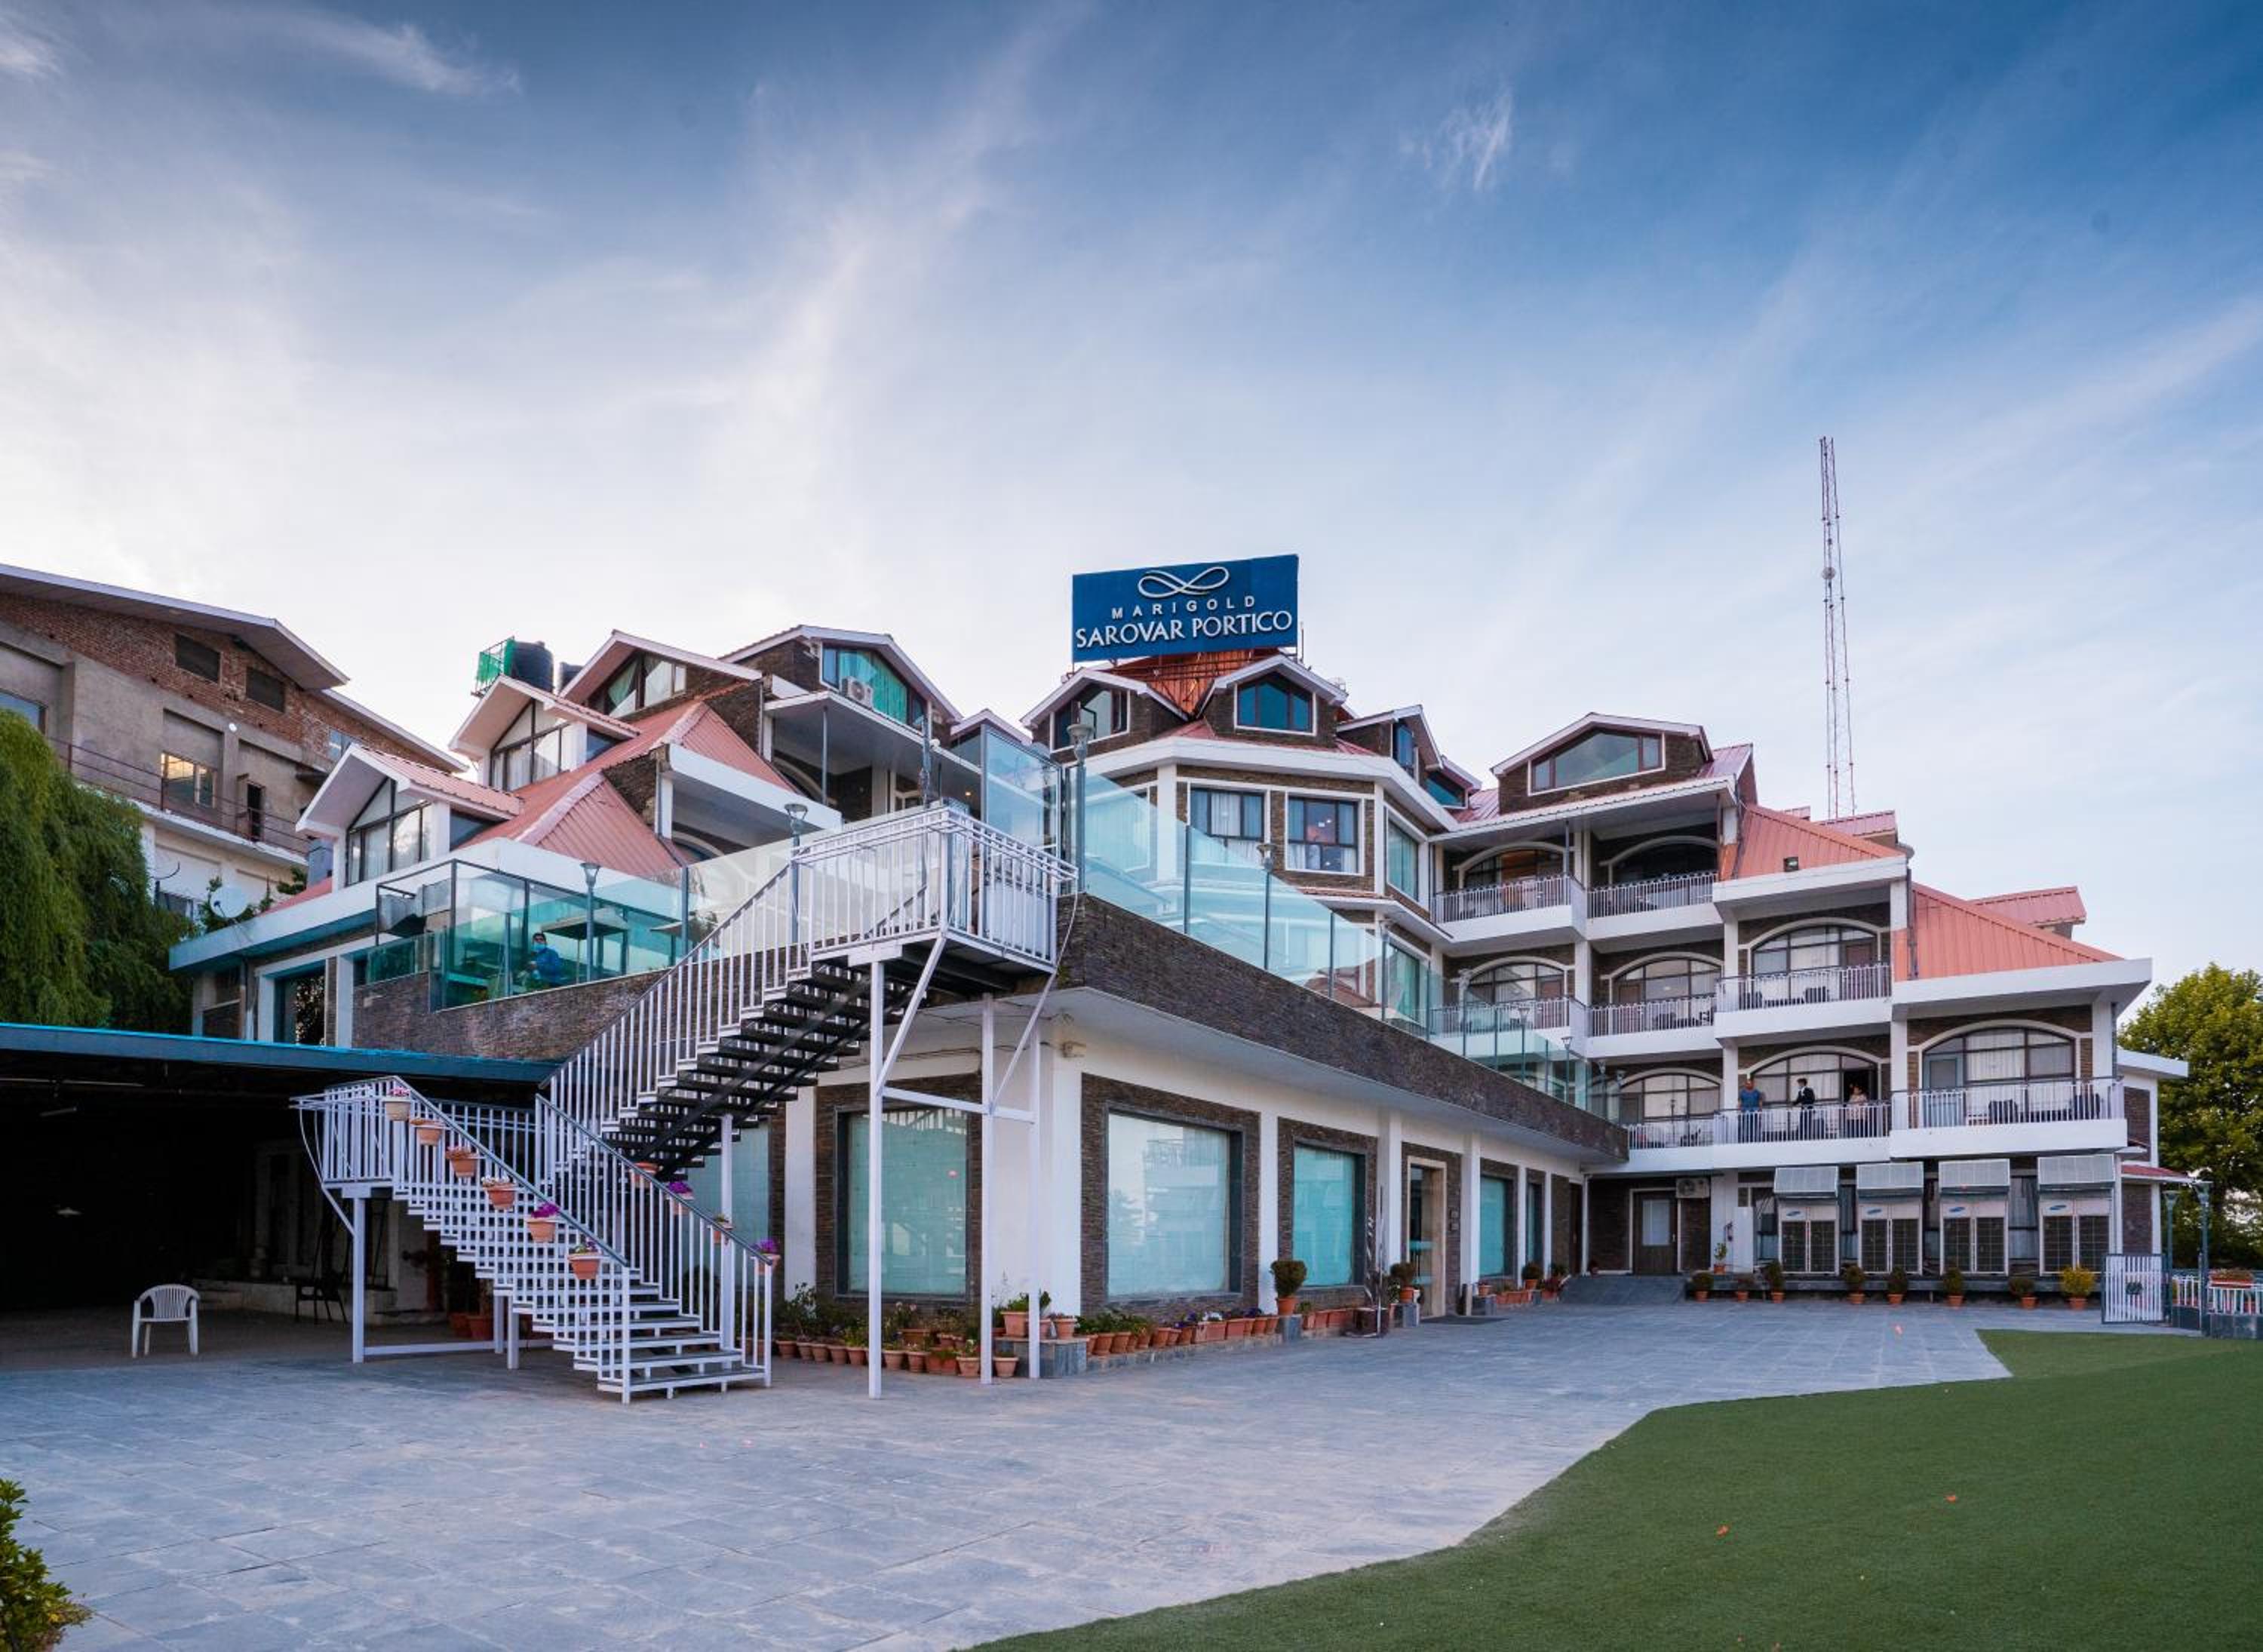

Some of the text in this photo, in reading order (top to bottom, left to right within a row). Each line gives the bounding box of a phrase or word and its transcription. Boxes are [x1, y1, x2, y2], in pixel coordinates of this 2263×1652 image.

[1111, 596, 1254, 619] MARIGOLD
[1076, 610, 1292, 647] SAROVAR PORTICO
